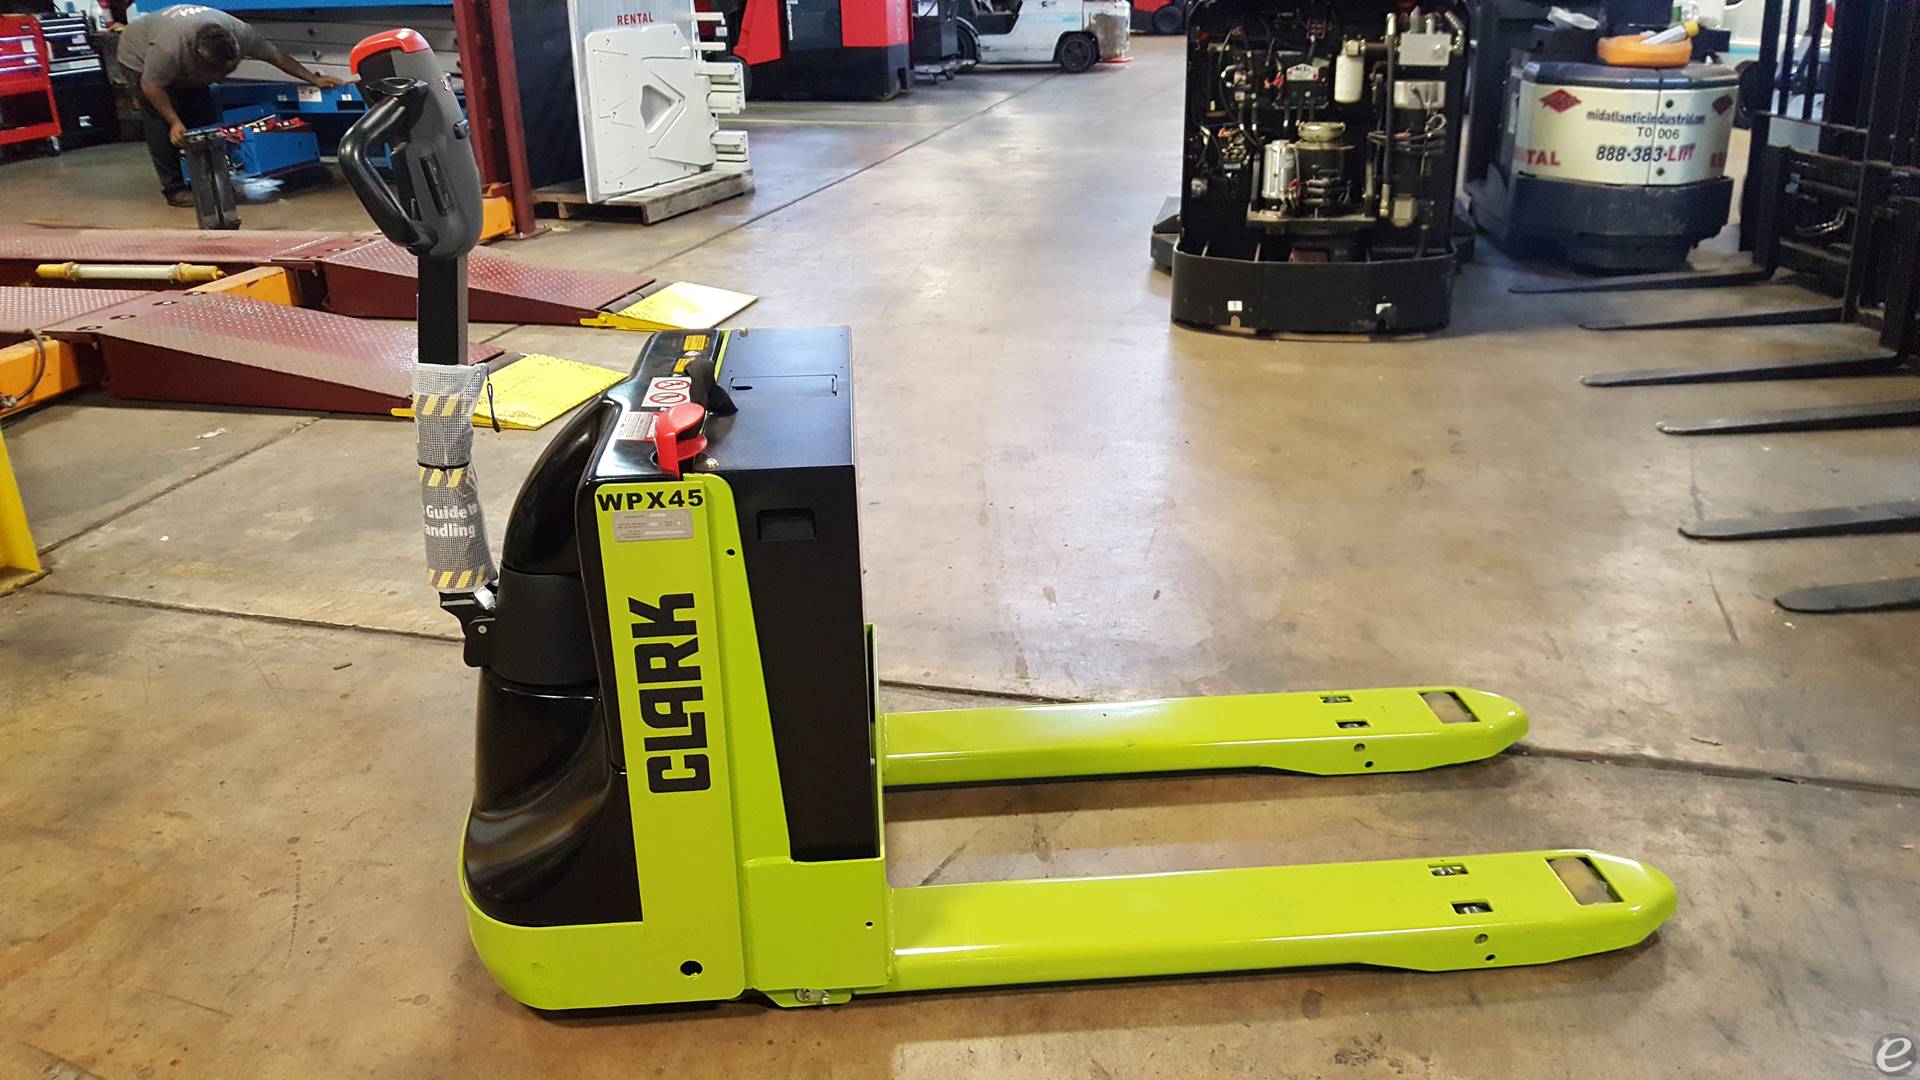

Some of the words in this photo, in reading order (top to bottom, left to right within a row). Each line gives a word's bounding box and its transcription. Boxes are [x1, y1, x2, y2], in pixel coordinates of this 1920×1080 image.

[616, 12, 654, 26] RENTAL
[596, 488, 704, 512] WPX45
[426, 505, 468, 519] Guide
[628, 593, 711, 793] CLARK
